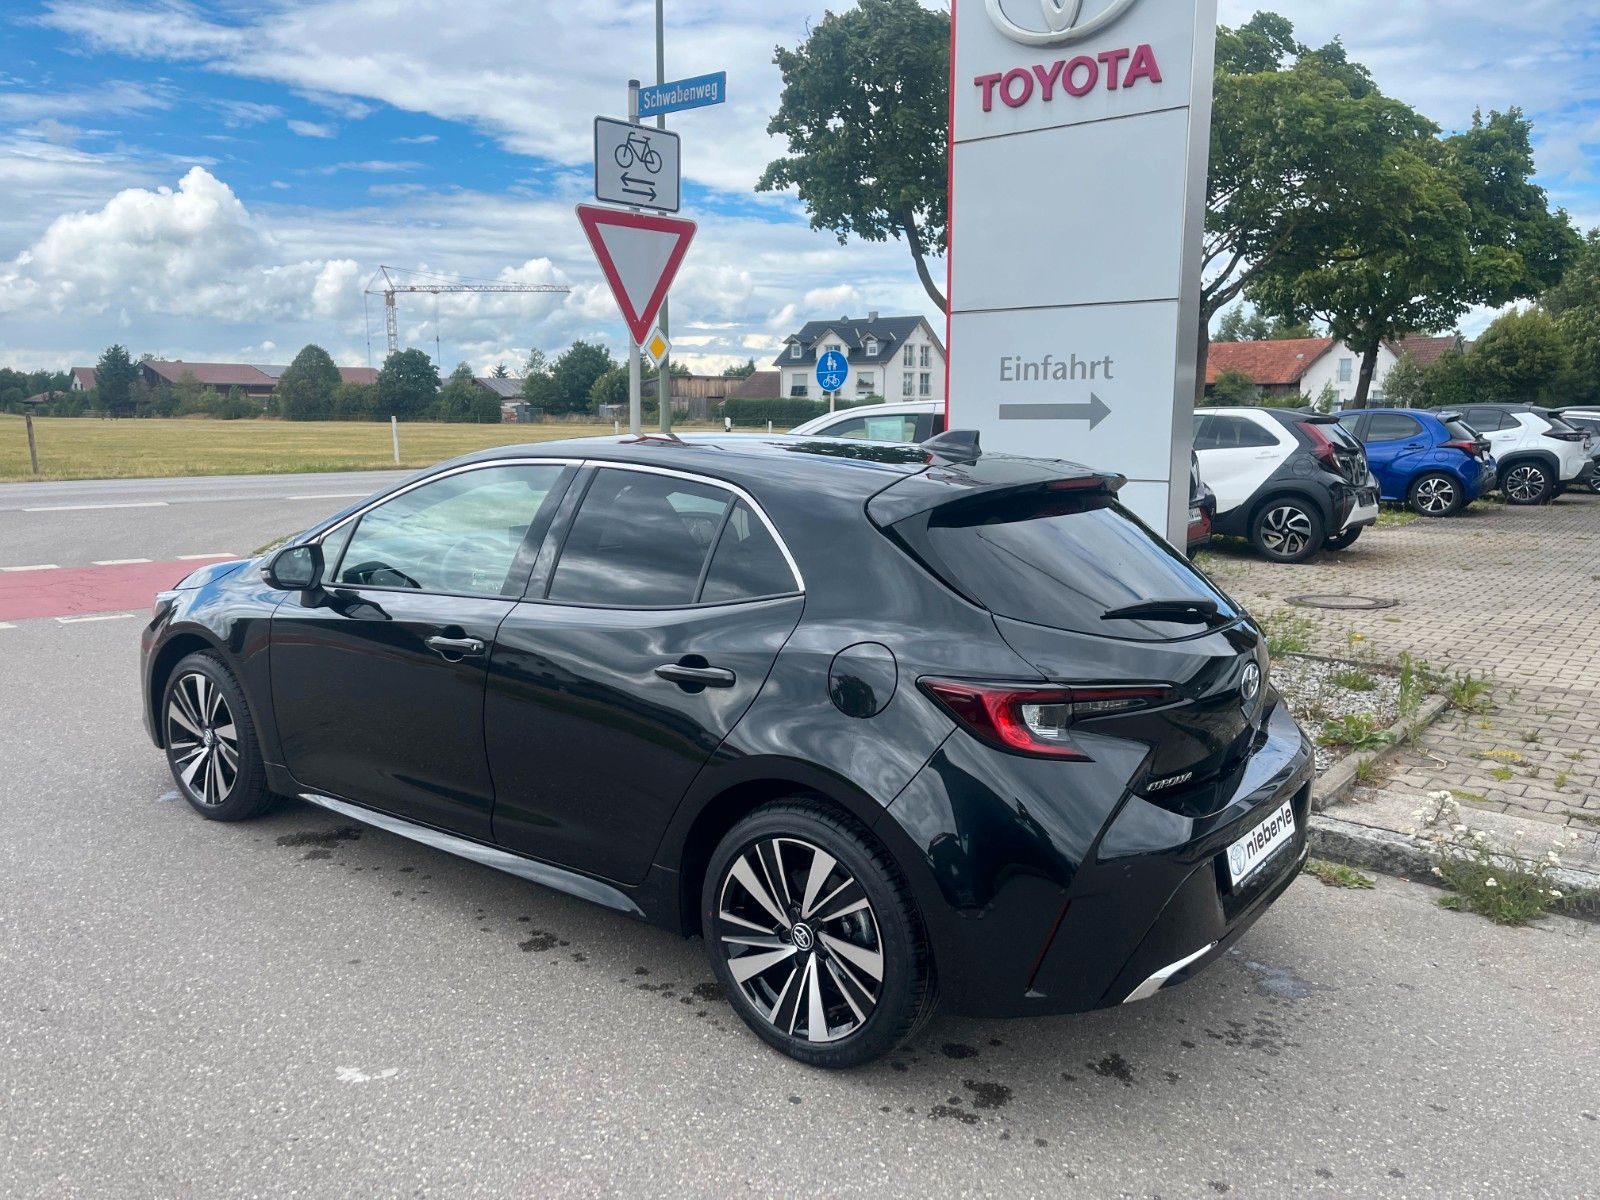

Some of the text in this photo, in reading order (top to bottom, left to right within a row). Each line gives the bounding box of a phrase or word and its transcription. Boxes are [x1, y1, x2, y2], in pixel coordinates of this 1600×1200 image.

[644, 82, 718, 109] Schwabenweg
[974, 44, 1162, 112] TOYOTA
[1000, 353, 1114, 381] Einfahrt
[1246, 807, 1292, 859] nieberle
